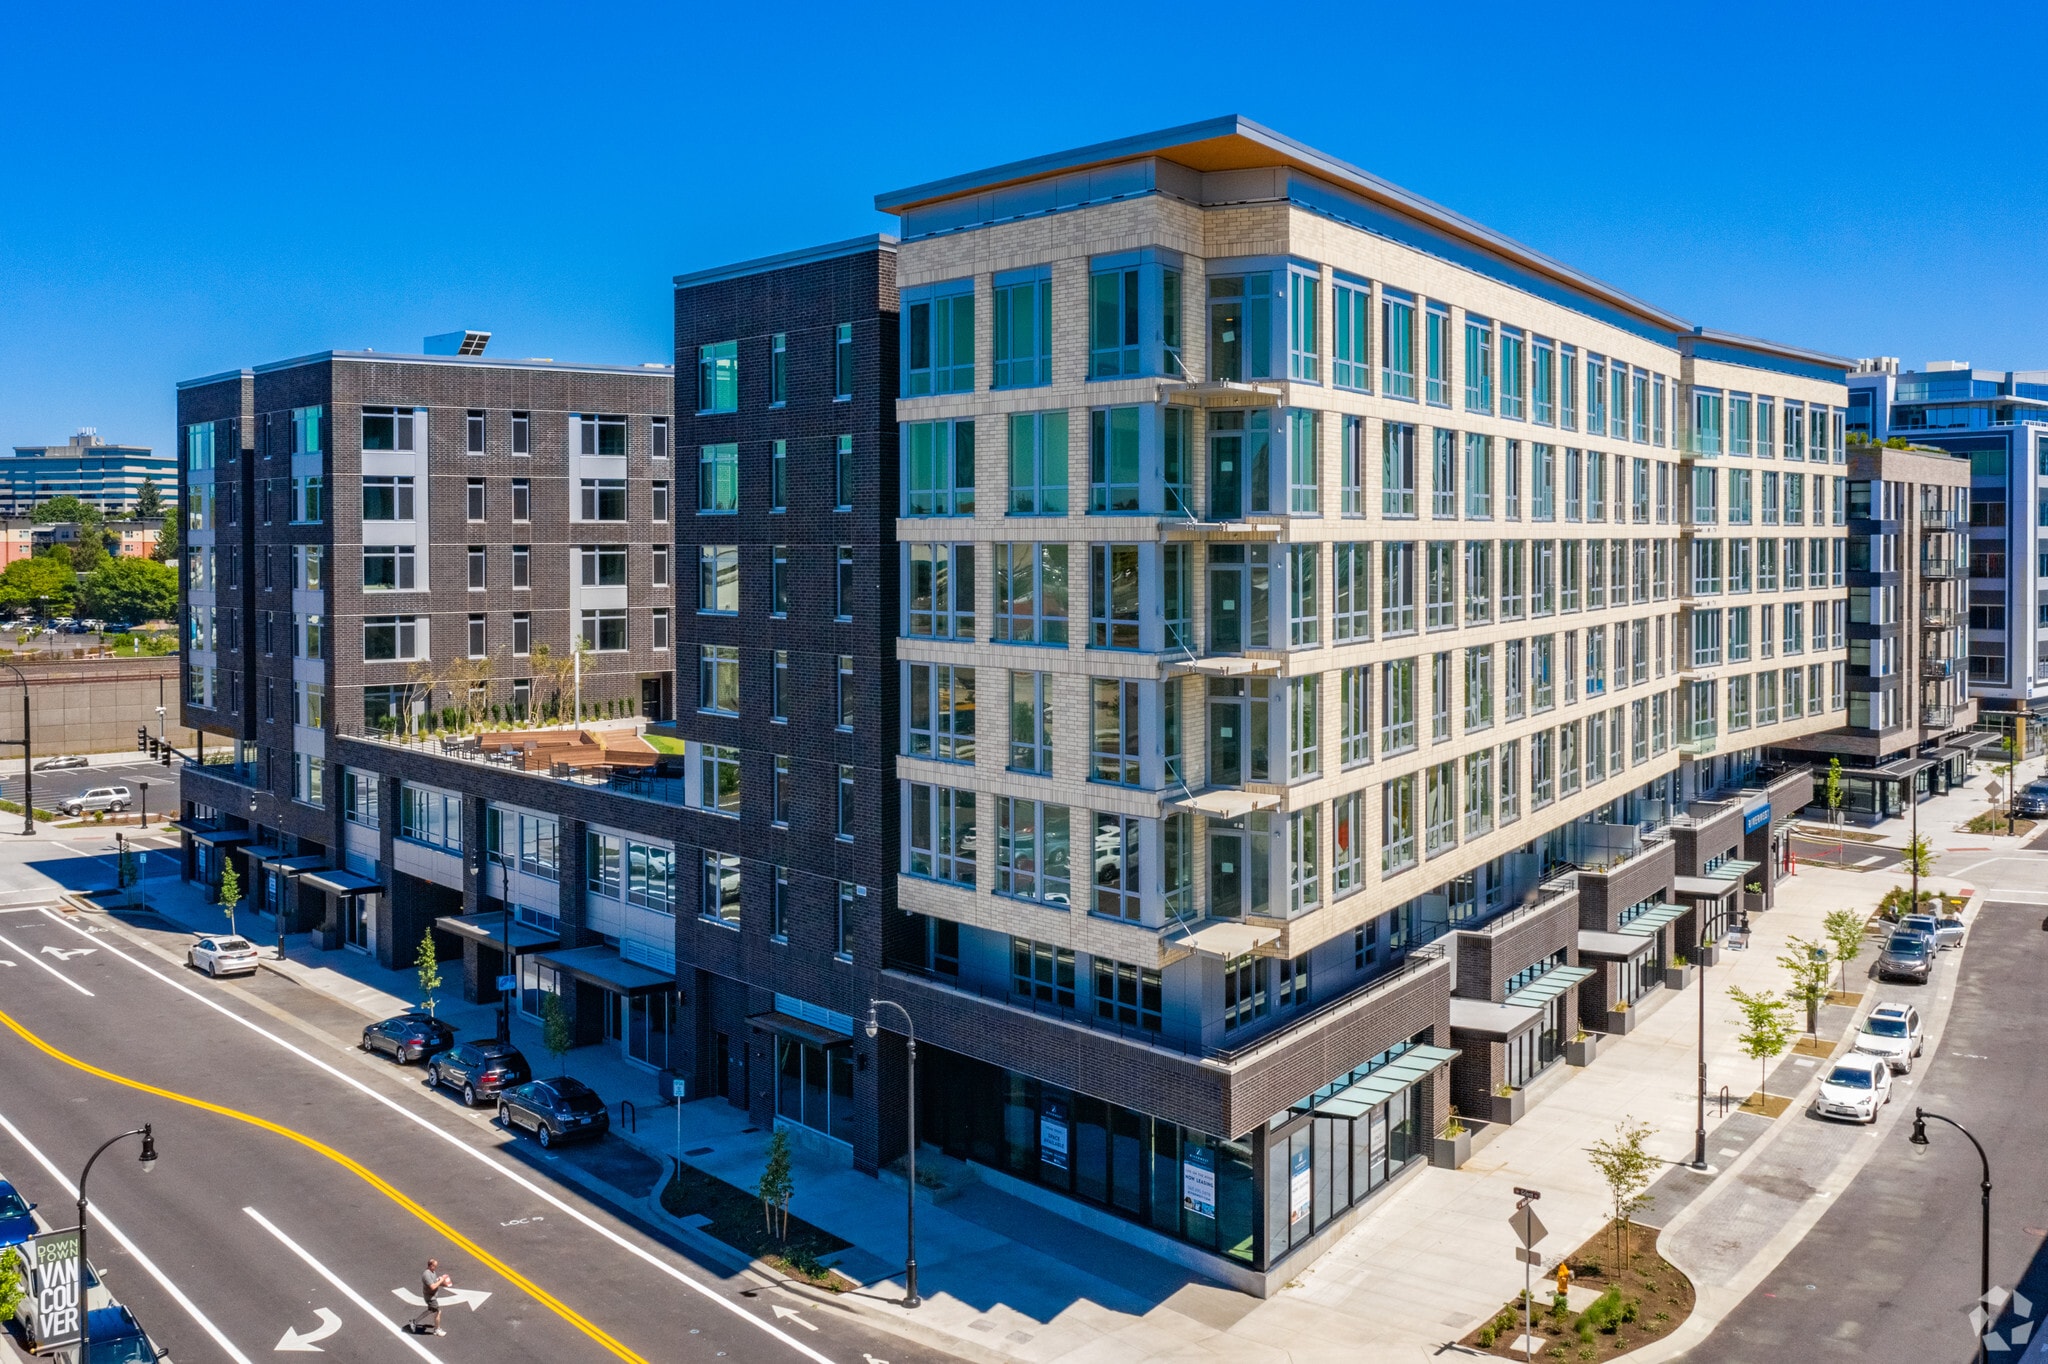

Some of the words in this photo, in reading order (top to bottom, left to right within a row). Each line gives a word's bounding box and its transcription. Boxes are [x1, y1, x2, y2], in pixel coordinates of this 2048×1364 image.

[37, 1239, 78, 1257] DOWN
[38, 1247, 78, 1263] TOWN
[39, 1256, 79, 1289] VAN
[40, 1281, 79, 1314] COU
[40, 1307, 79, 1338] VER
